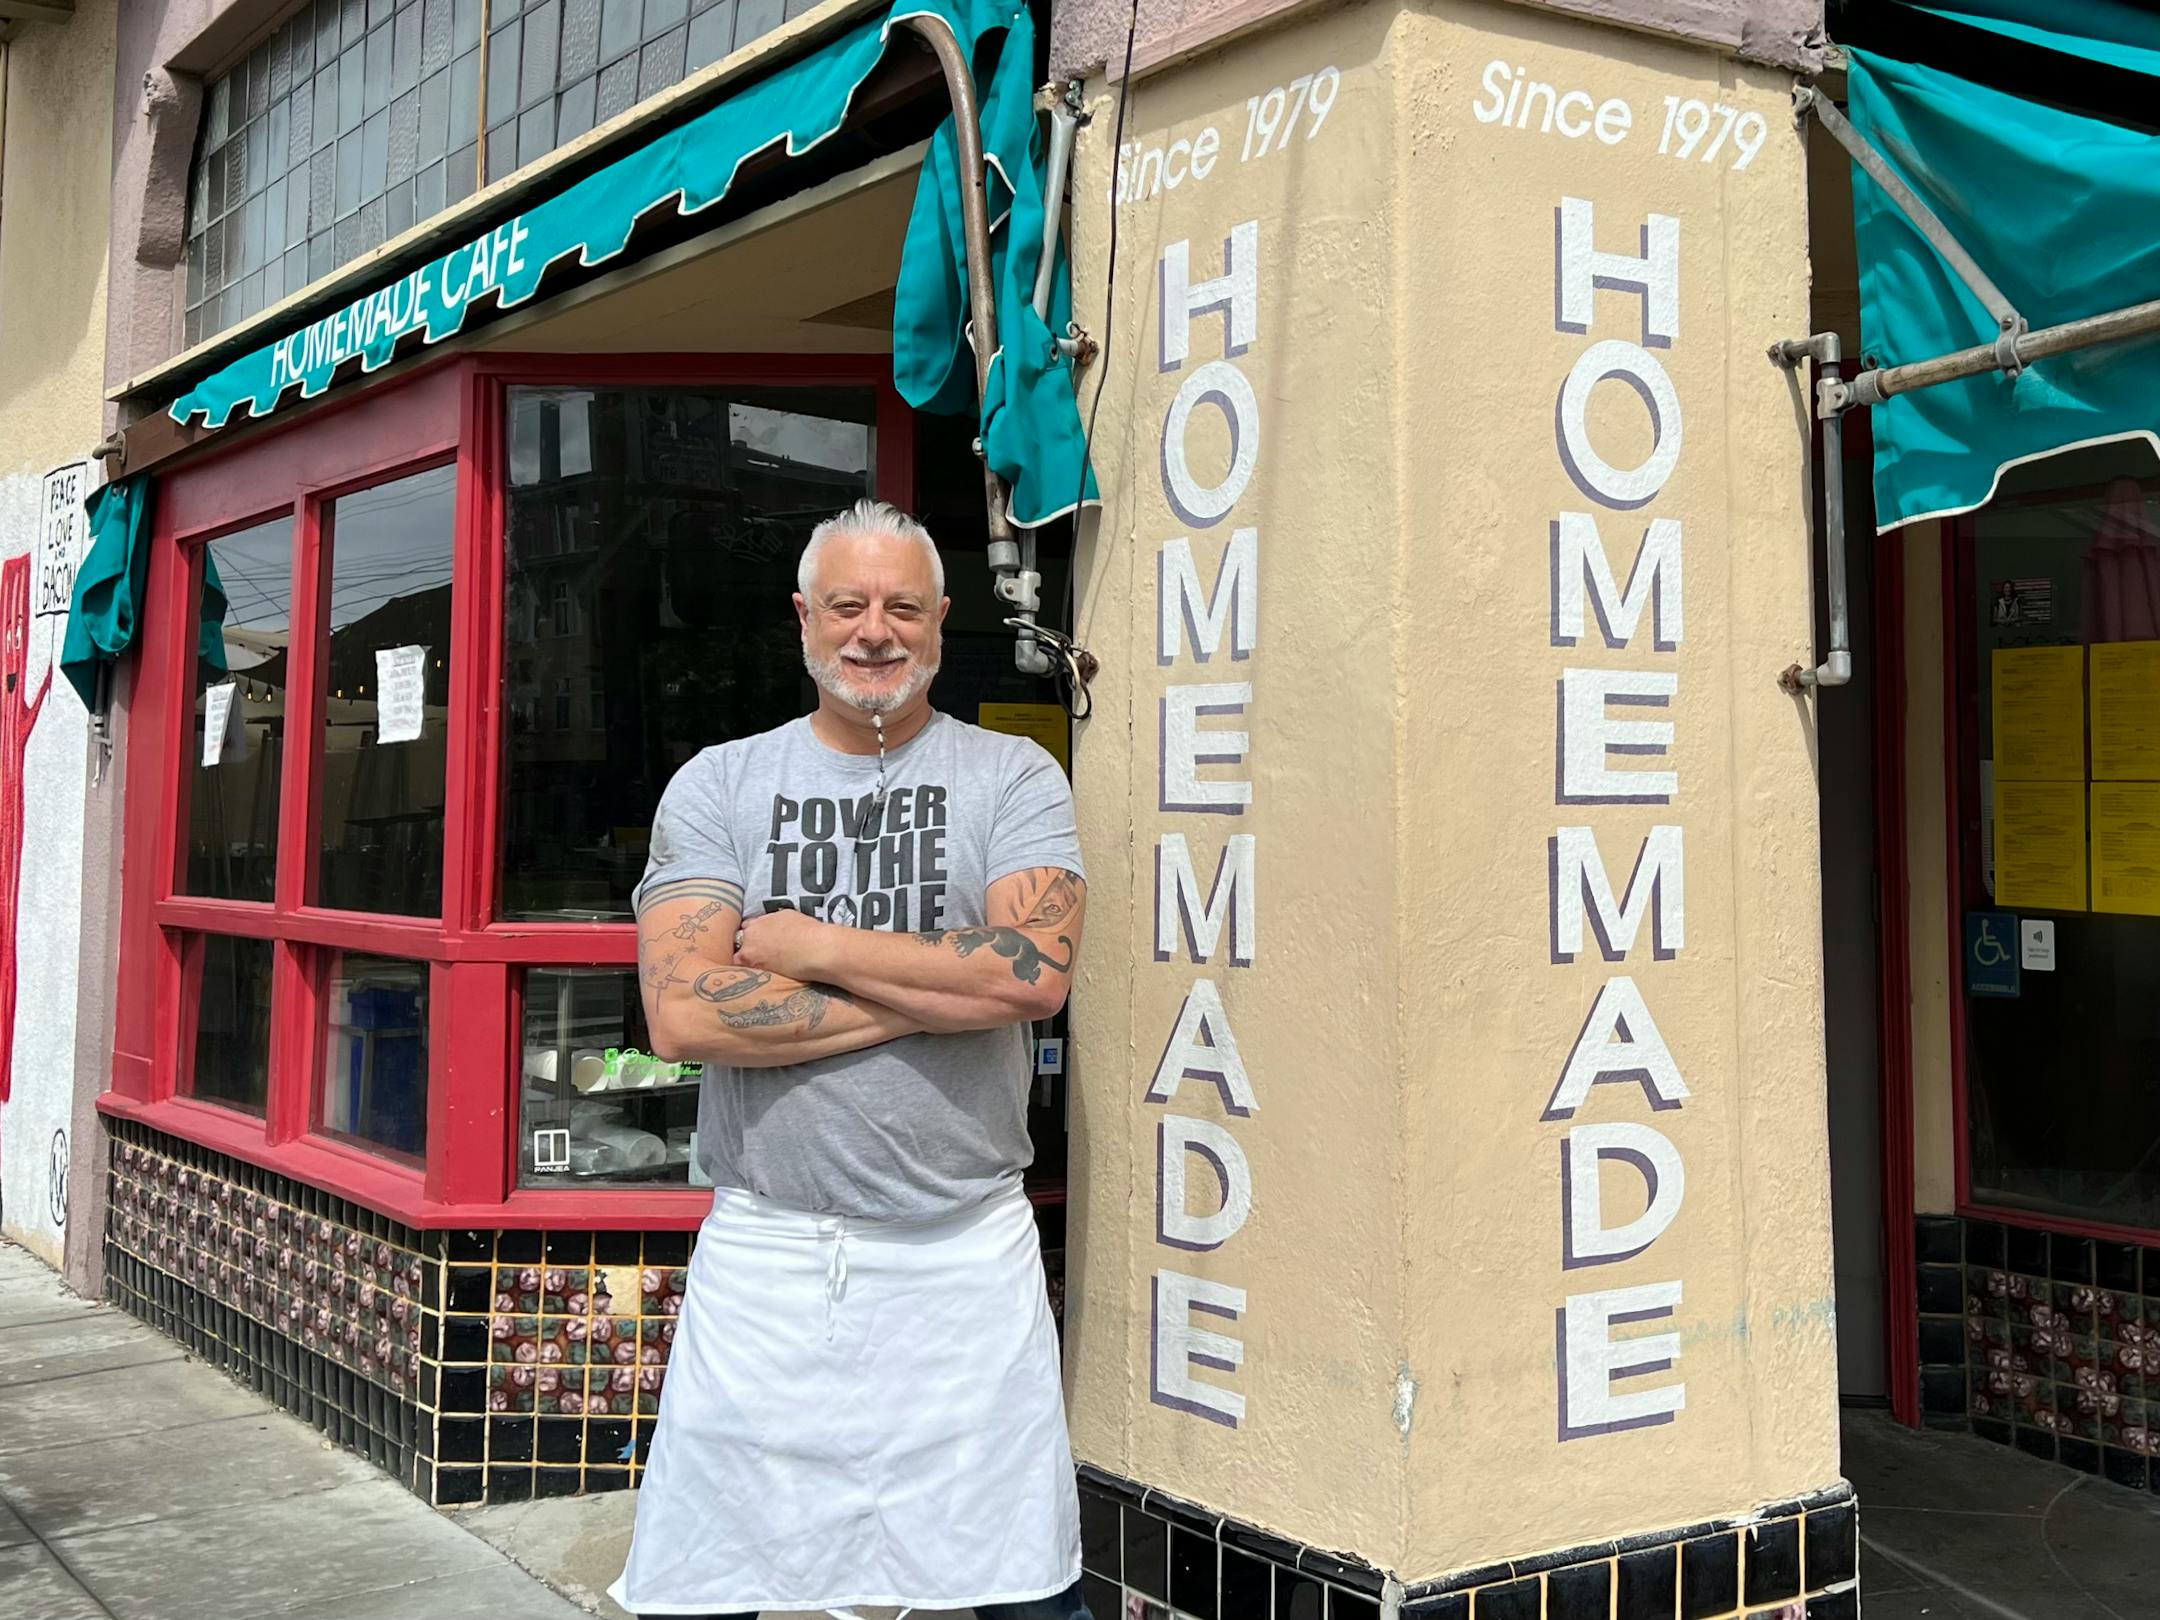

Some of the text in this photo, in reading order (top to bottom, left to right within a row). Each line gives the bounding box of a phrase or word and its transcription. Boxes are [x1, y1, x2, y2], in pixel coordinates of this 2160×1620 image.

[1106, 64, 1341, 208] Since 1979
[1472, 59, 1768, 171] Since 1979
[270, 215, 530, 388] HOMEMADE CAFE
[47, 512, 74, 550] LOVE
[49, 473, 77, 514] PEACE
[42, 560, 77, 611] BACON
[769, 784, 947, 842] POWER
[1147, 219, 1263, 1428] HOMEMADE
[1540, 195, 1690, 1441] HOMEMADE
[766, 828, 947, 897] TO THE
